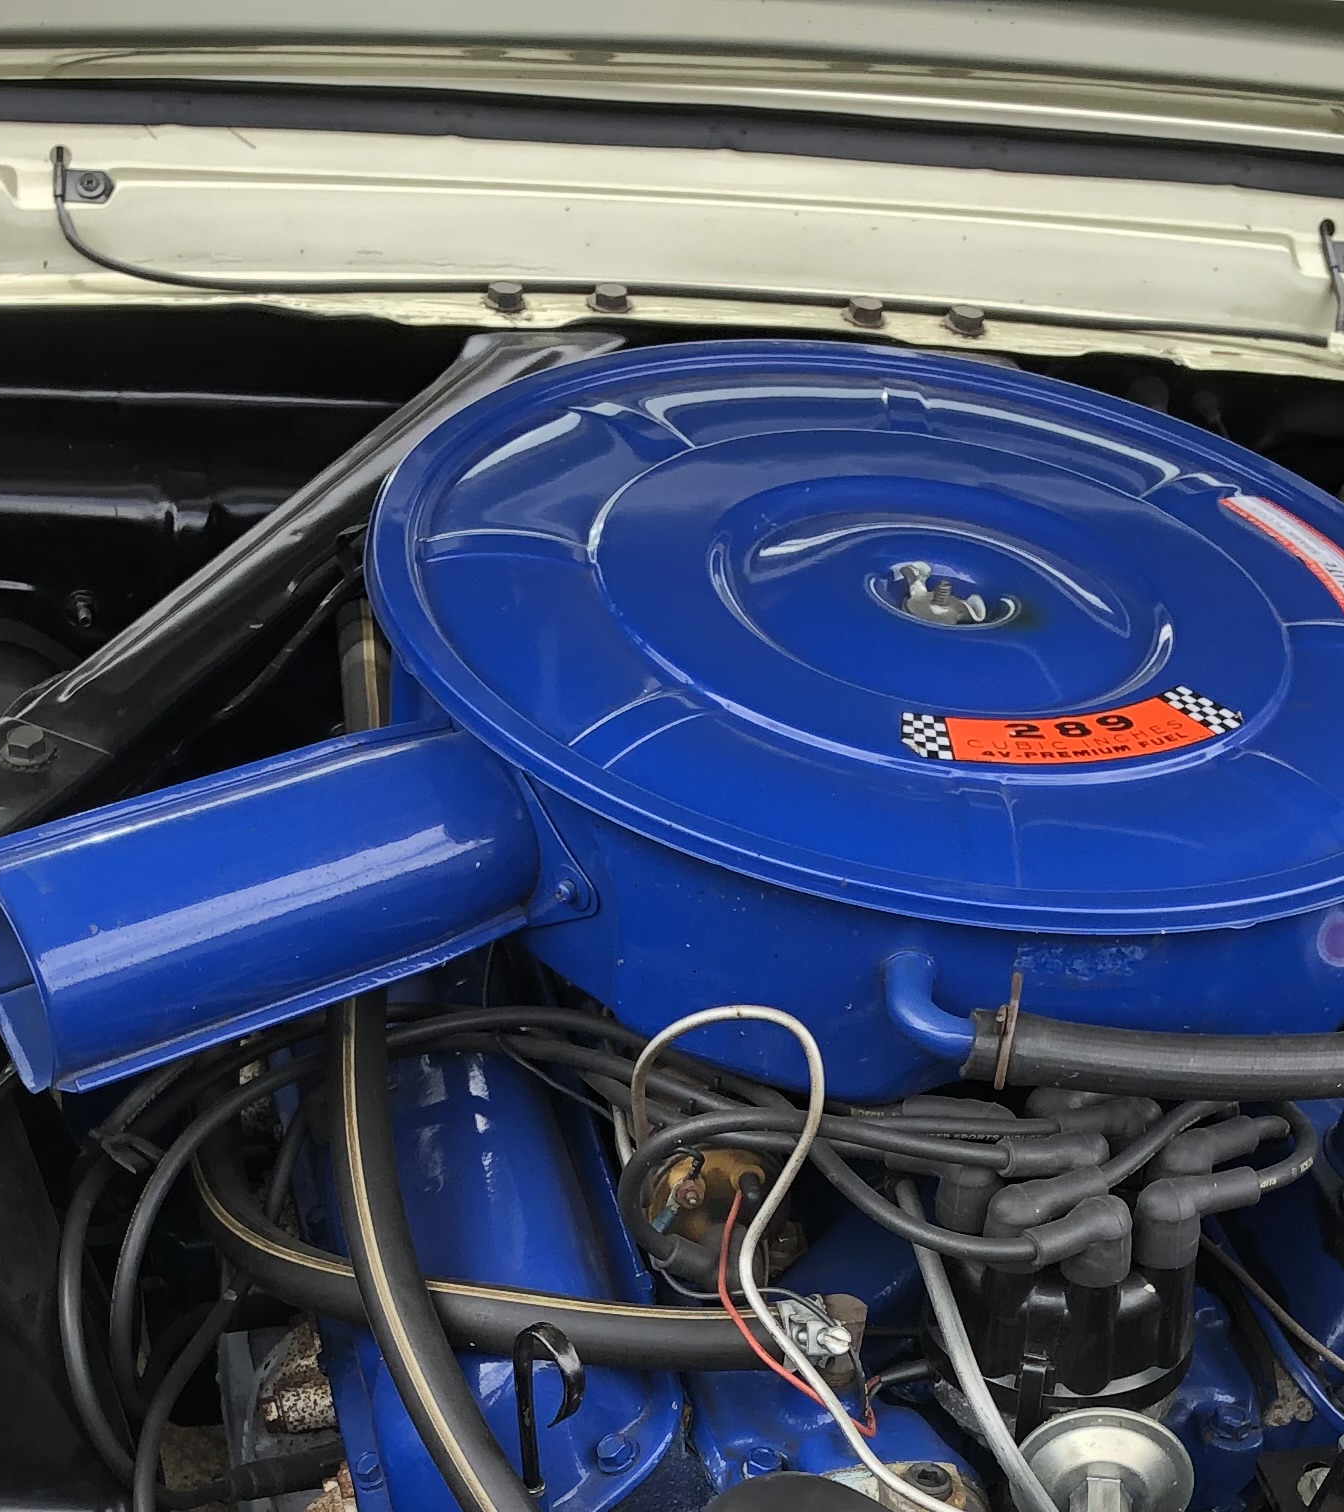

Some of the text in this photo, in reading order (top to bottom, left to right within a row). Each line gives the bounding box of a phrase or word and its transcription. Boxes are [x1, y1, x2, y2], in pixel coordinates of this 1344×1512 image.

[966, 718, 1183, 751] CUBIC INCHES
[1002, 713, 1135, 741] 289
[981, 731, 1189, 760] 4V-PREMIUM FUEL
